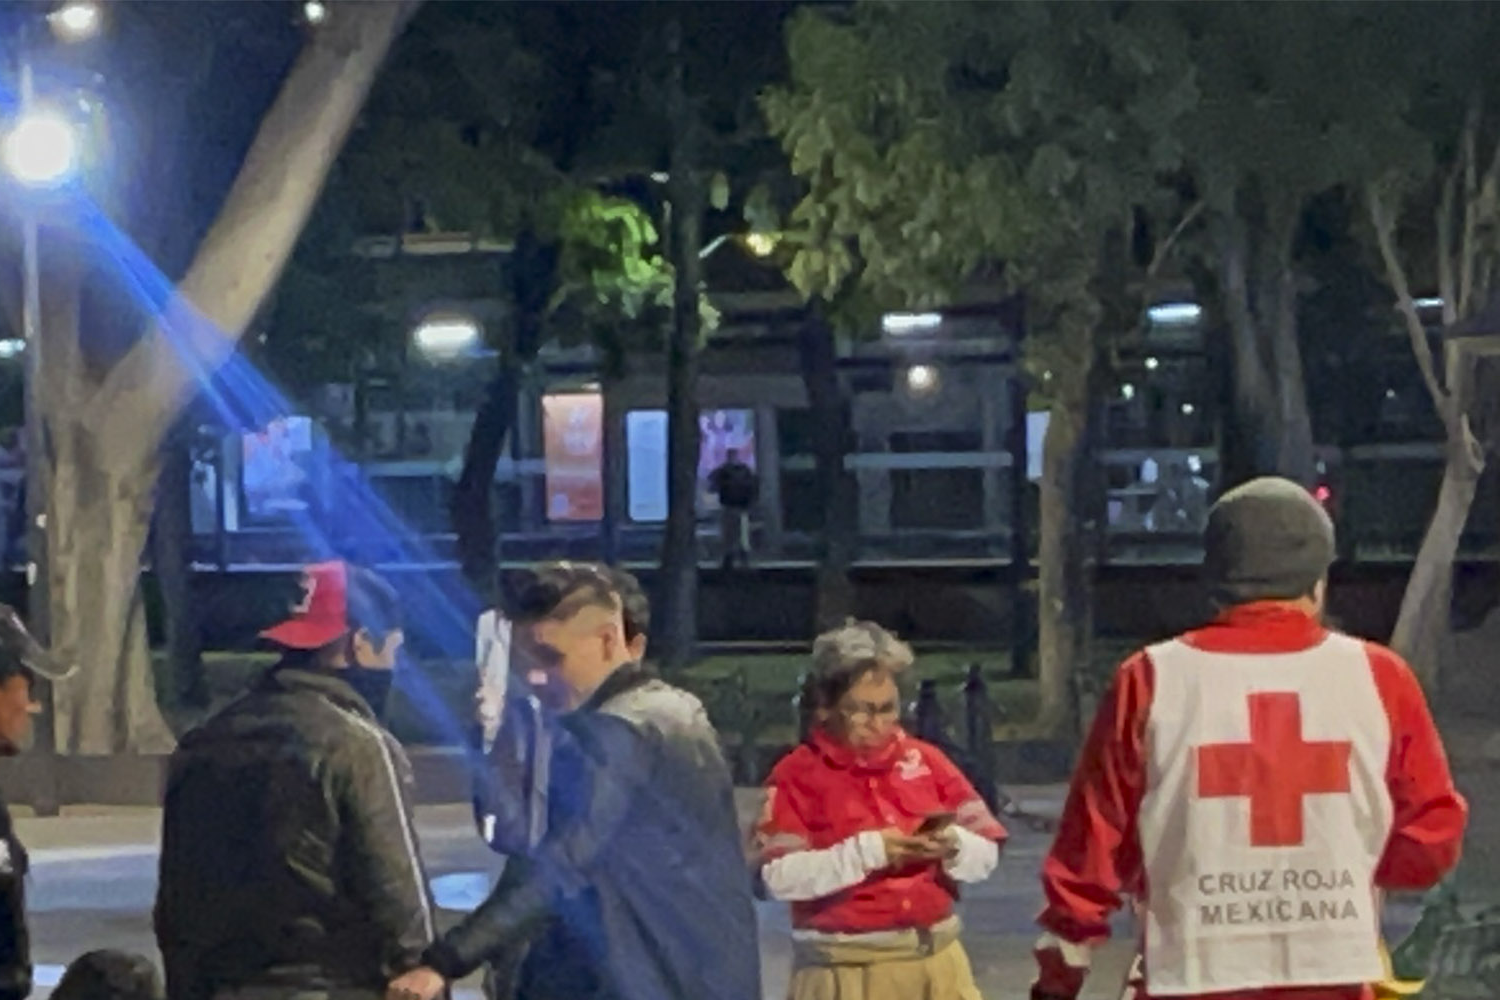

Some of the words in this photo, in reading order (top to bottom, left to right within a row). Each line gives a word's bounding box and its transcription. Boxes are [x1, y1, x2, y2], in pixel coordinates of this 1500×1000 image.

[1198, 869, 1274, 896] CRUZ
[1283, 869, 1356, 891] ROJA
[1200, 898, 1359, 925] MEXICANA
